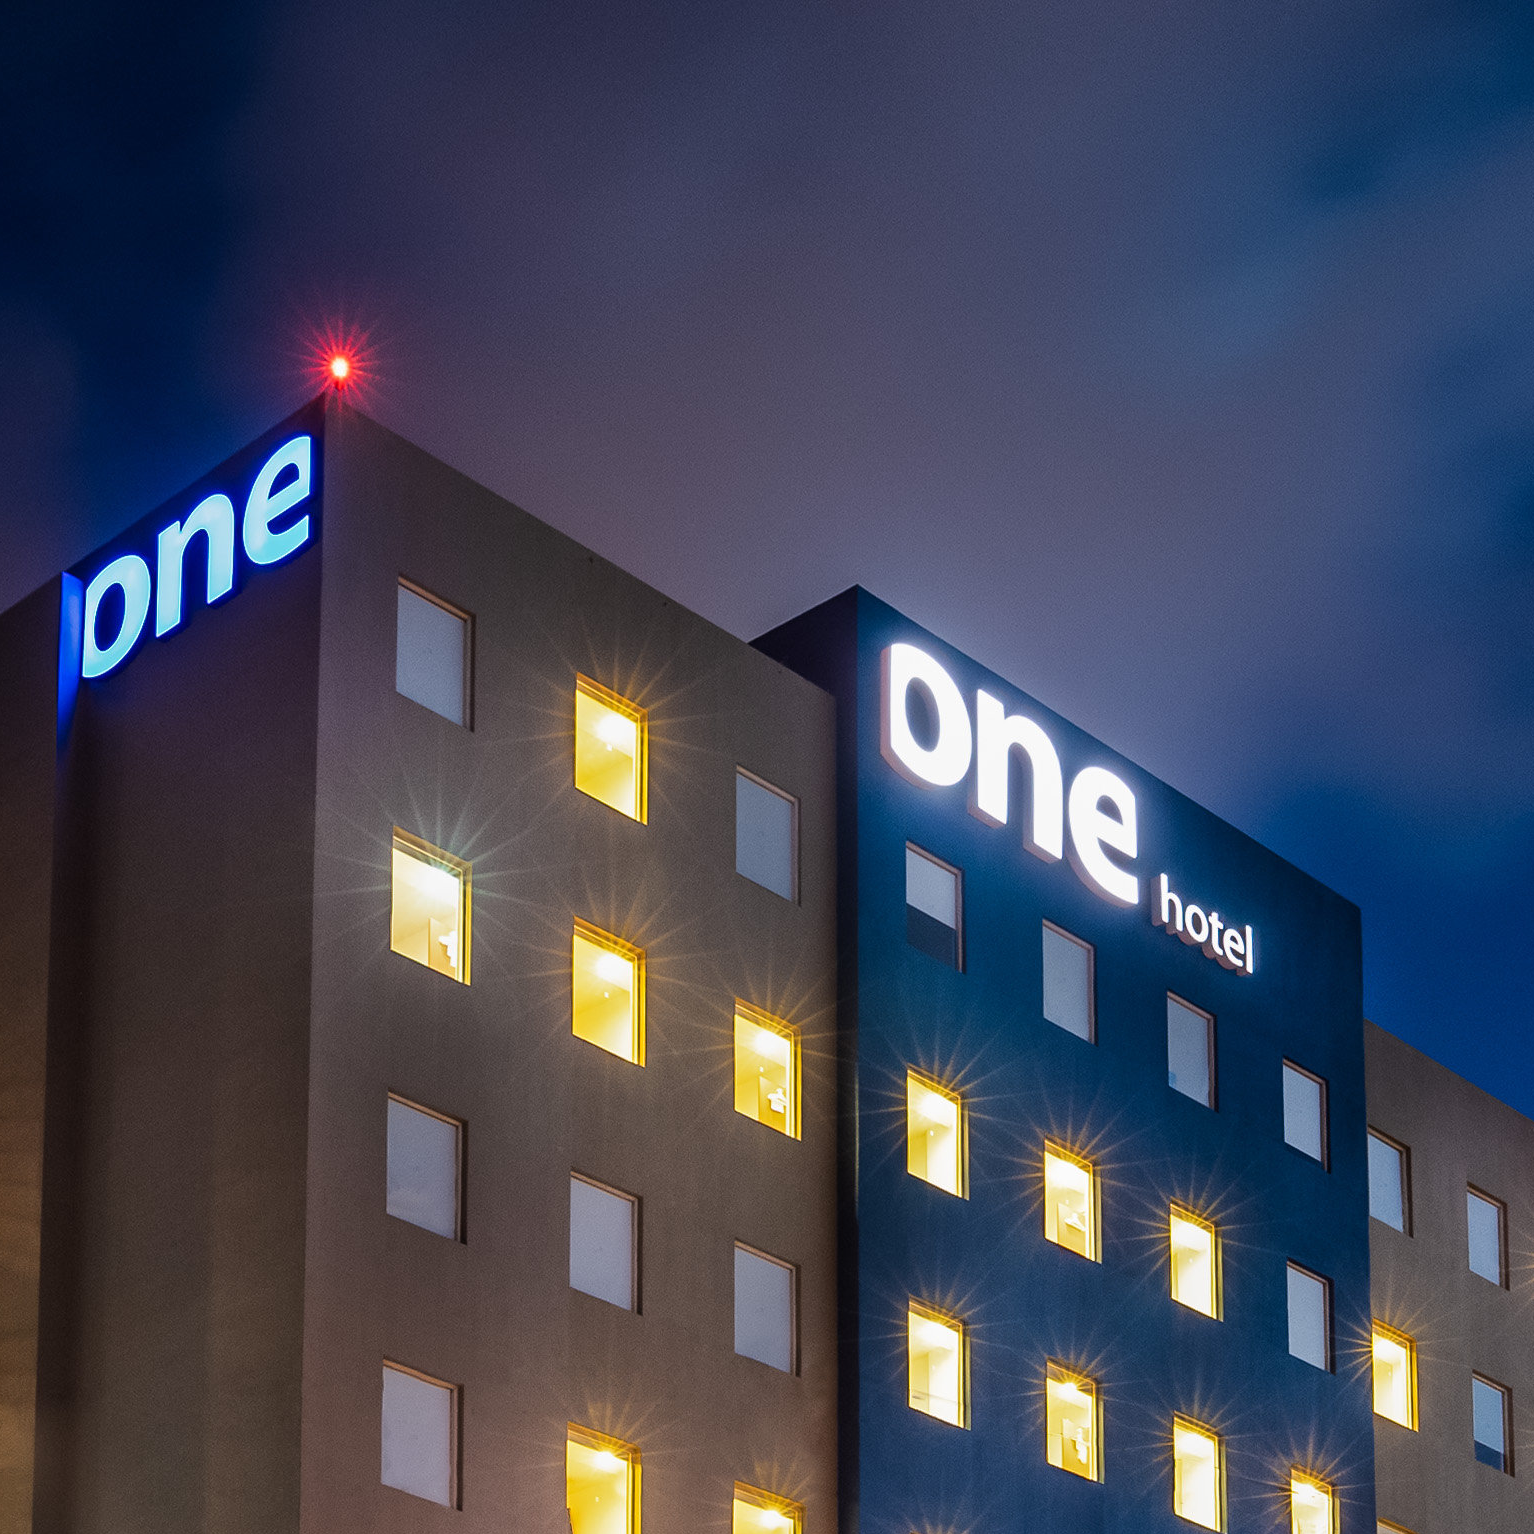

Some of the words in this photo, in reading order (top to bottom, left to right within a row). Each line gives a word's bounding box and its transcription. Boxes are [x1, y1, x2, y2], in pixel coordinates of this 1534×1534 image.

[82, 436, 311, 678] one
[880, 643, 1139, 906] one
[1153, 873, 1254, 976] hotel
